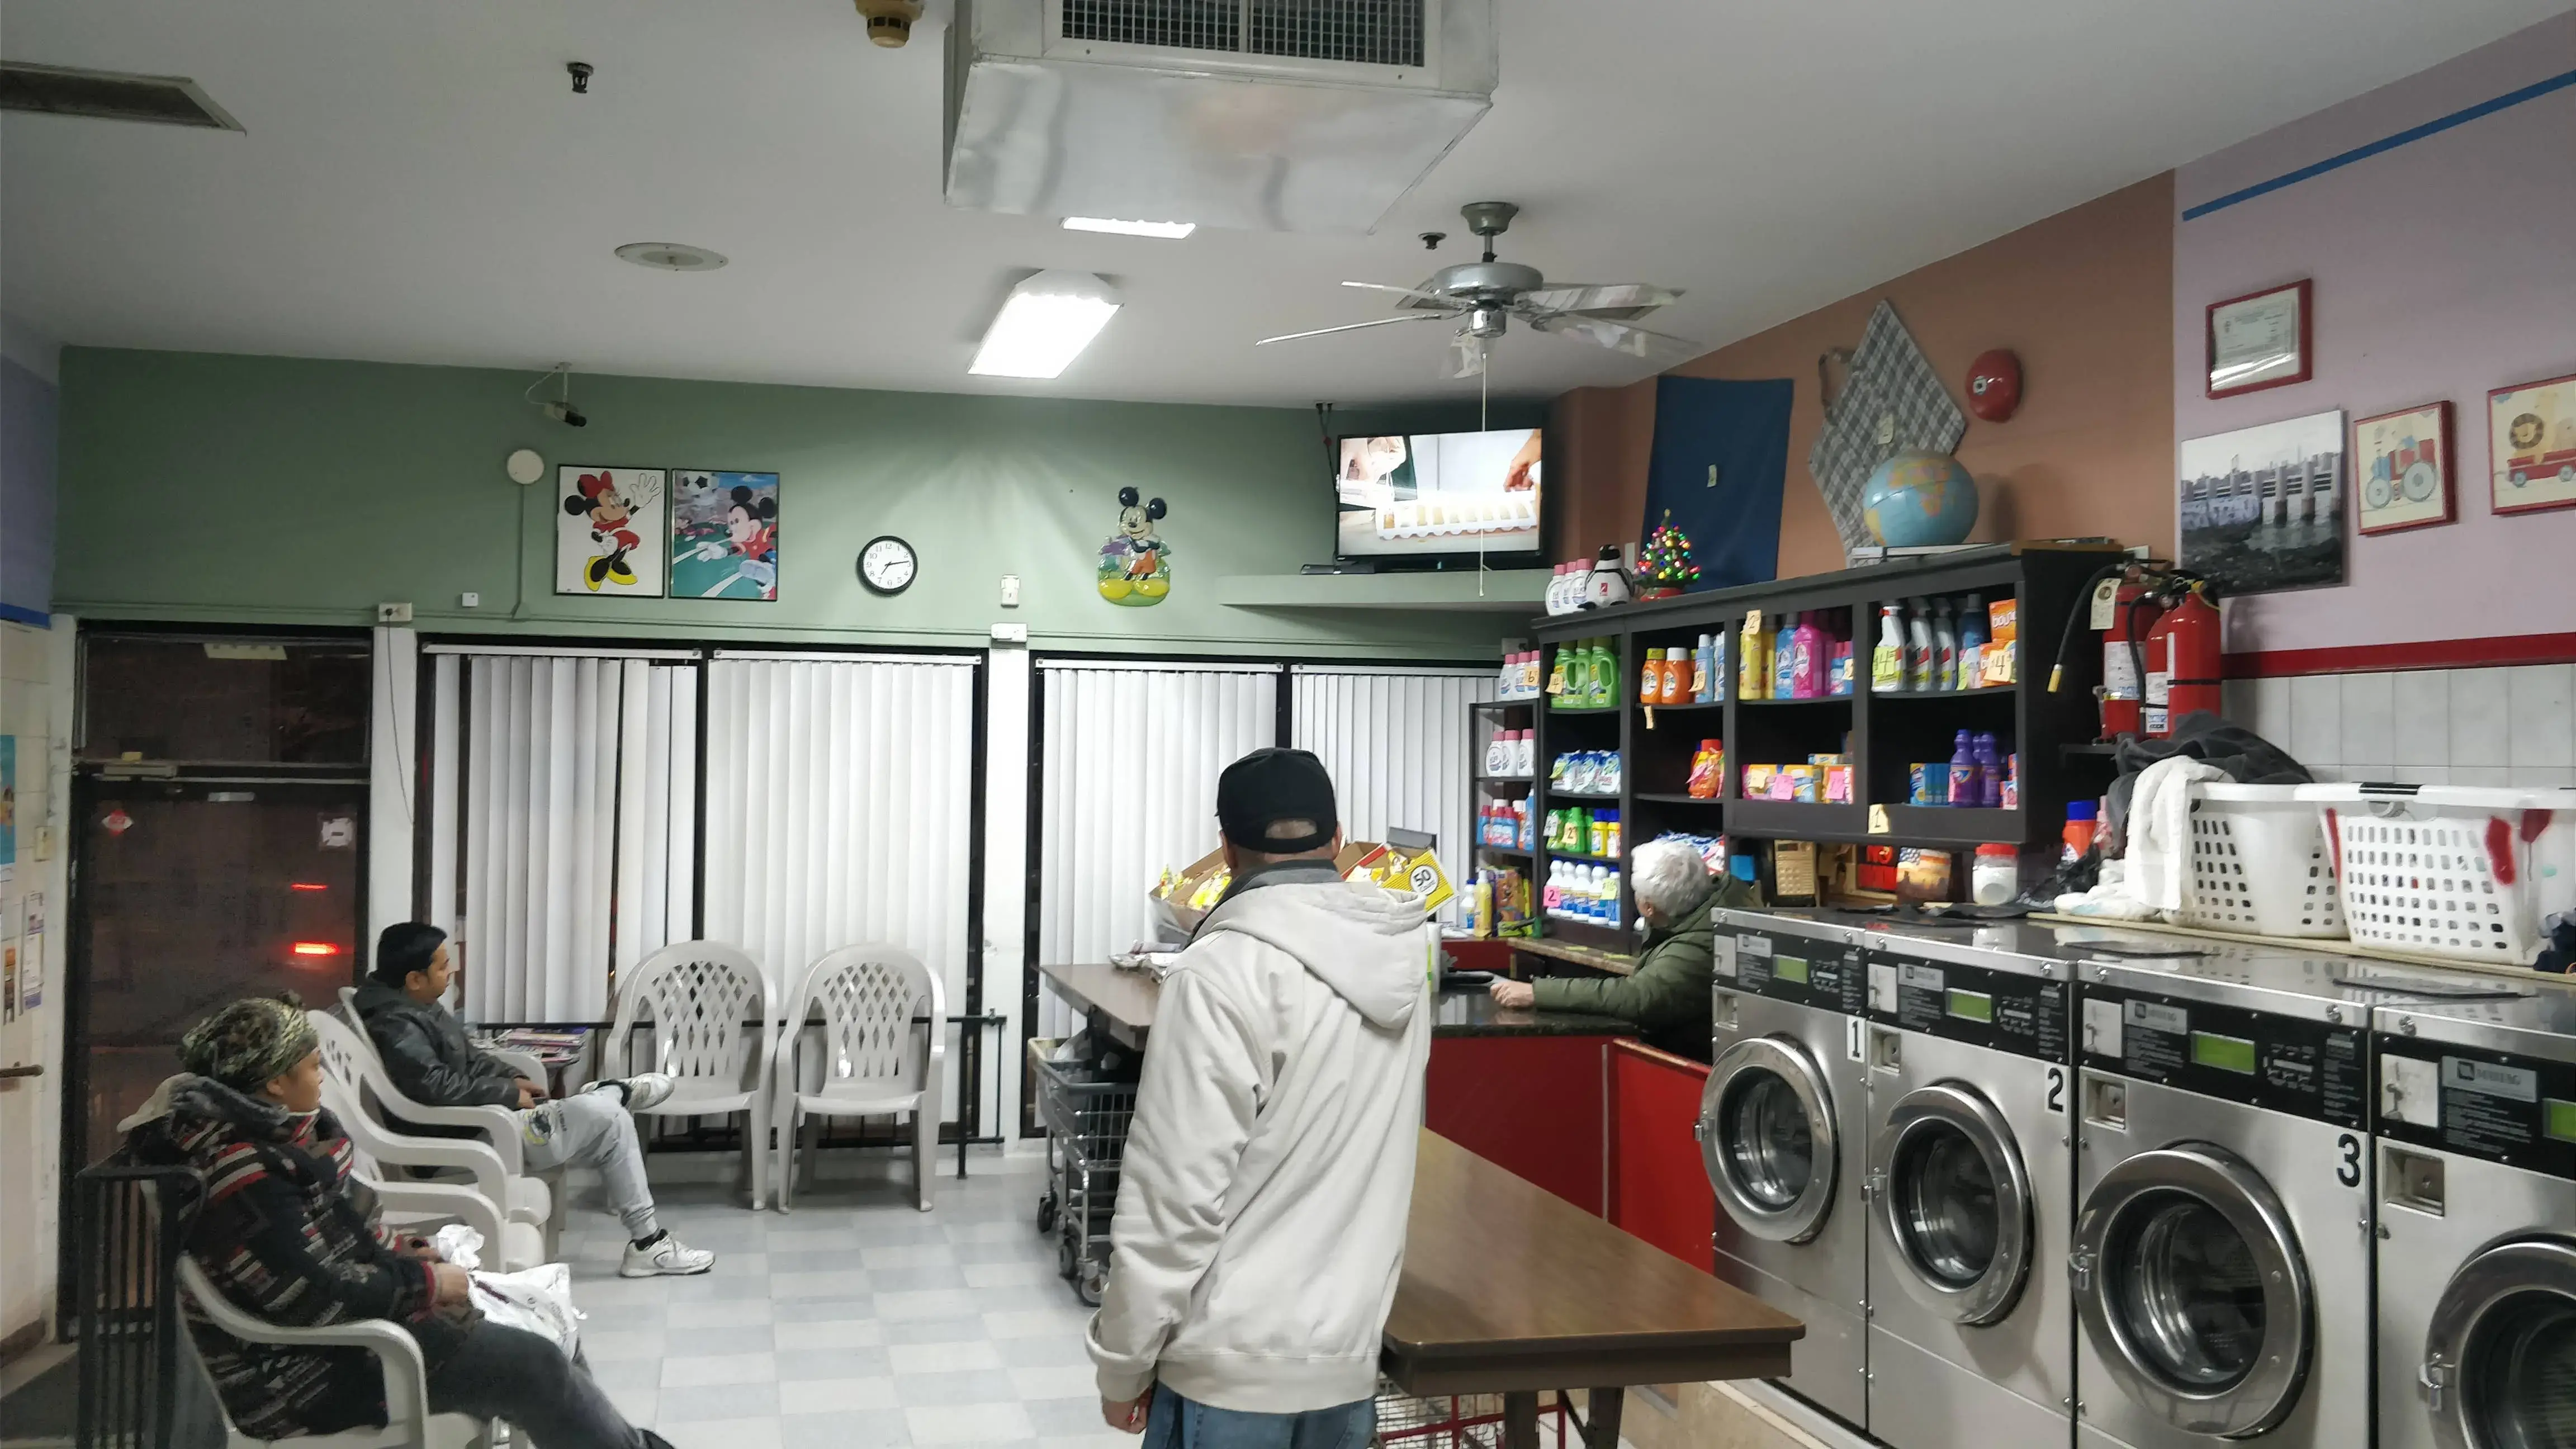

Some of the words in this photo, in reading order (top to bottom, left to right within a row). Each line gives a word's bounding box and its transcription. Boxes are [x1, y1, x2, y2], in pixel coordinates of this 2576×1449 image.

[1413, 869, 1431, 887] 50
[1548, 889, 1557, 901] 2
[1852, 1020, 1860, 1058] 1
[2048, 1067, 2063, 1112] 2
[2337, 1133, 2360, 1187] 3
